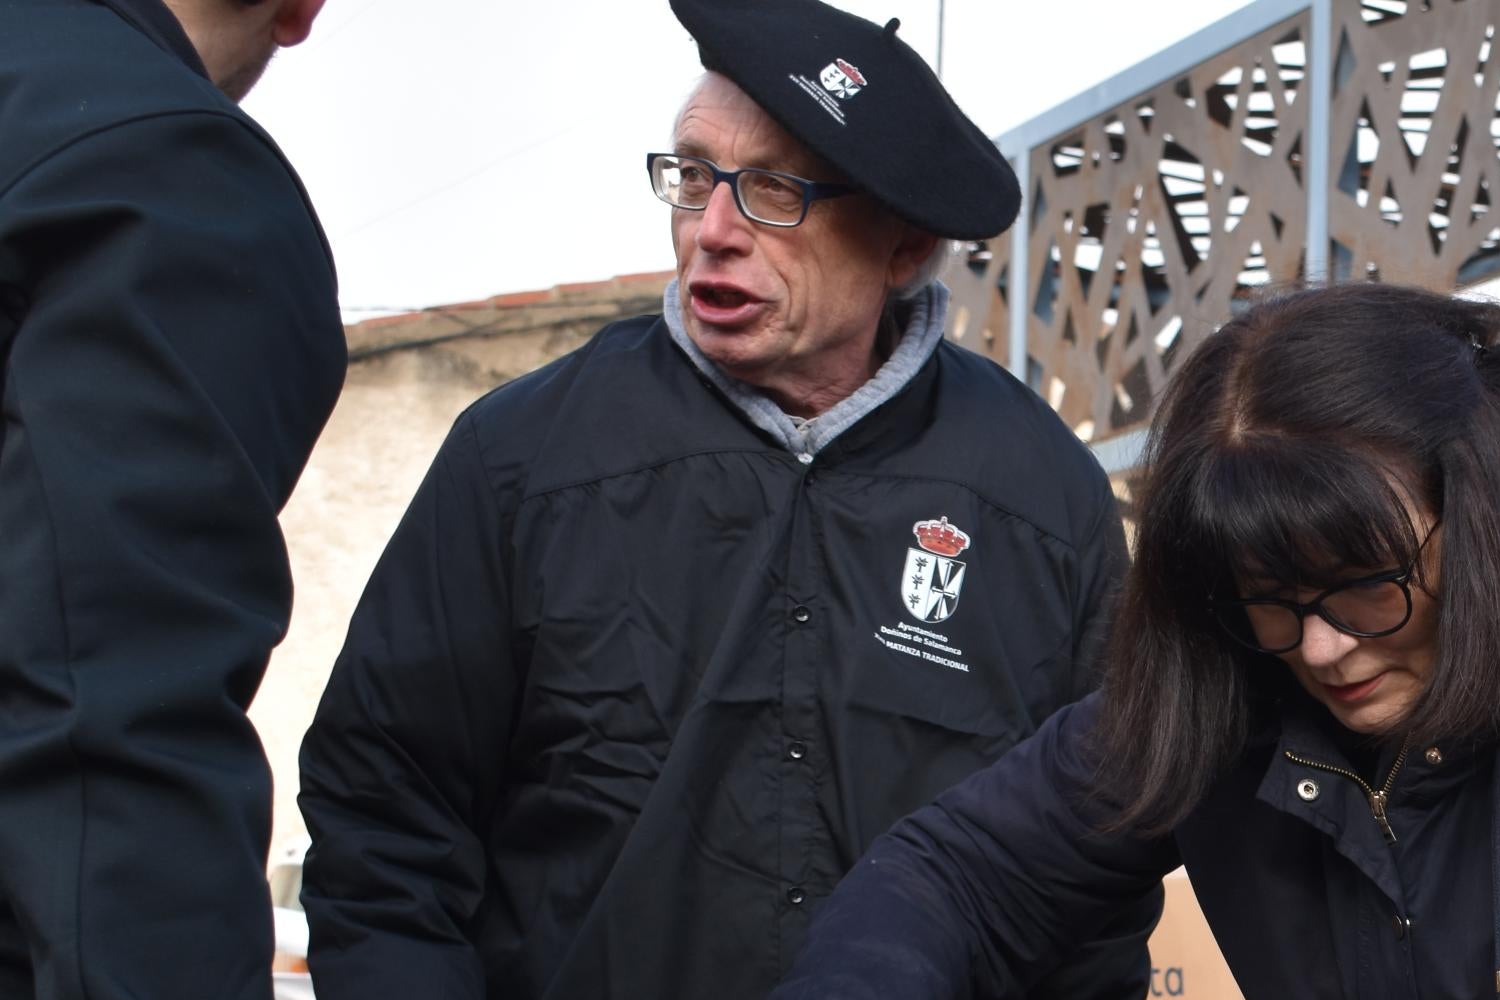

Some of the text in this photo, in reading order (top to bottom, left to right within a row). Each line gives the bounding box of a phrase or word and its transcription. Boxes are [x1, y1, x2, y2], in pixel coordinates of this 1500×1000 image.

[880, 625, 913, 641] Doñinos
[912, 634, 923, 644] de
[923, 637, 962, 656] Salamanca
[898, 621, 948, 643] Ayuntamiento
[885, 640, 970, 673] MATANZA TRADICIONAL
